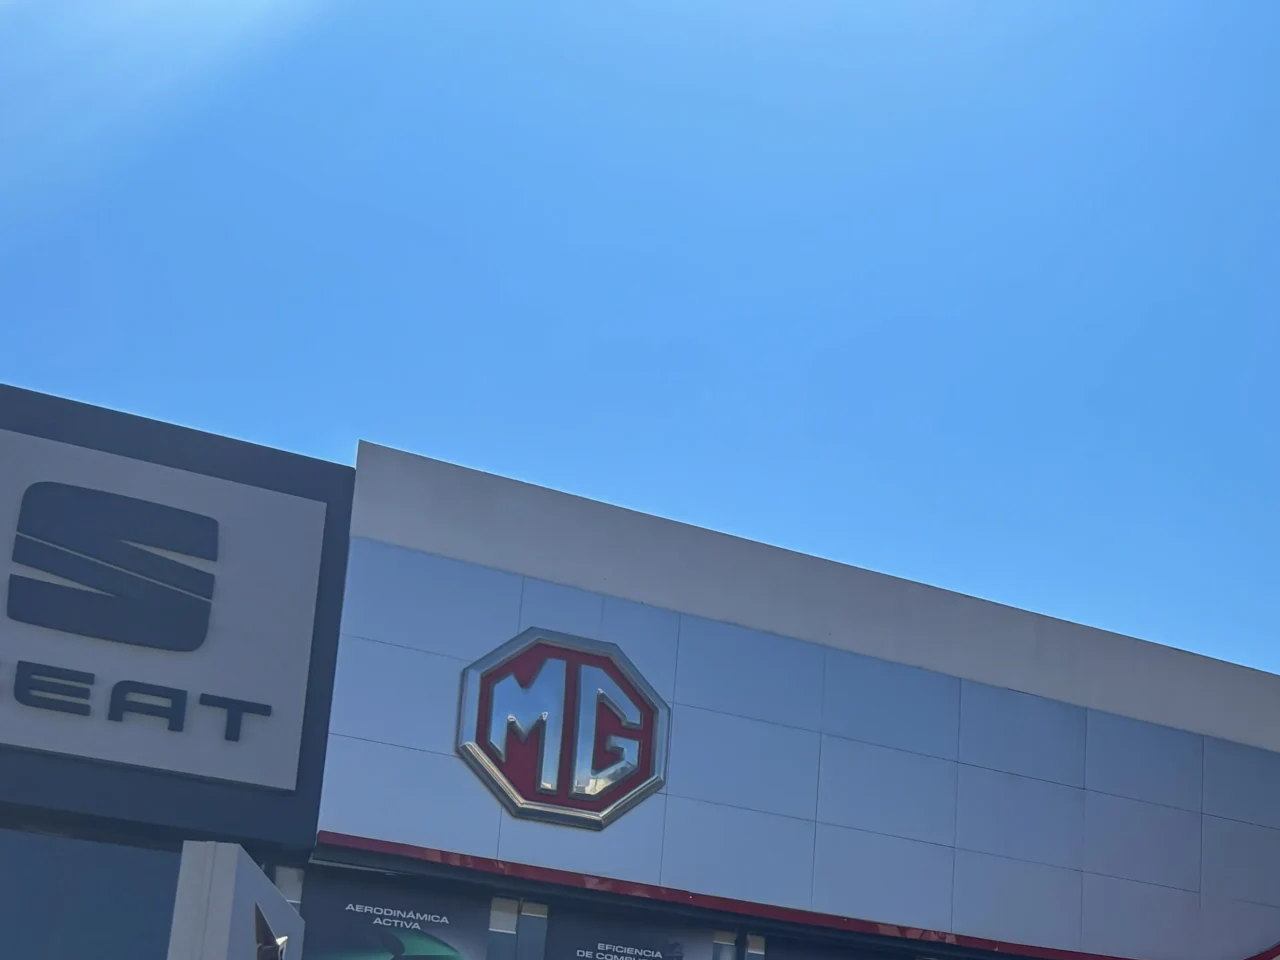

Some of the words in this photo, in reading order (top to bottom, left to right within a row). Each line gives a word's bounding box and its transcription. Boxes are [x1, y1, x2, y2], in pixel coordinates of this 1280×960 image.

[13, 659, 272, 743] EAT
[485, 655, 645, 798] MG
[344, 902, 450, 925] AERODINÁMICA
[372, 916, 422, 931] ACTIVA
[576, 949, 593, 959] DE
[597, 942, 663, 960] EFICIENCIA
